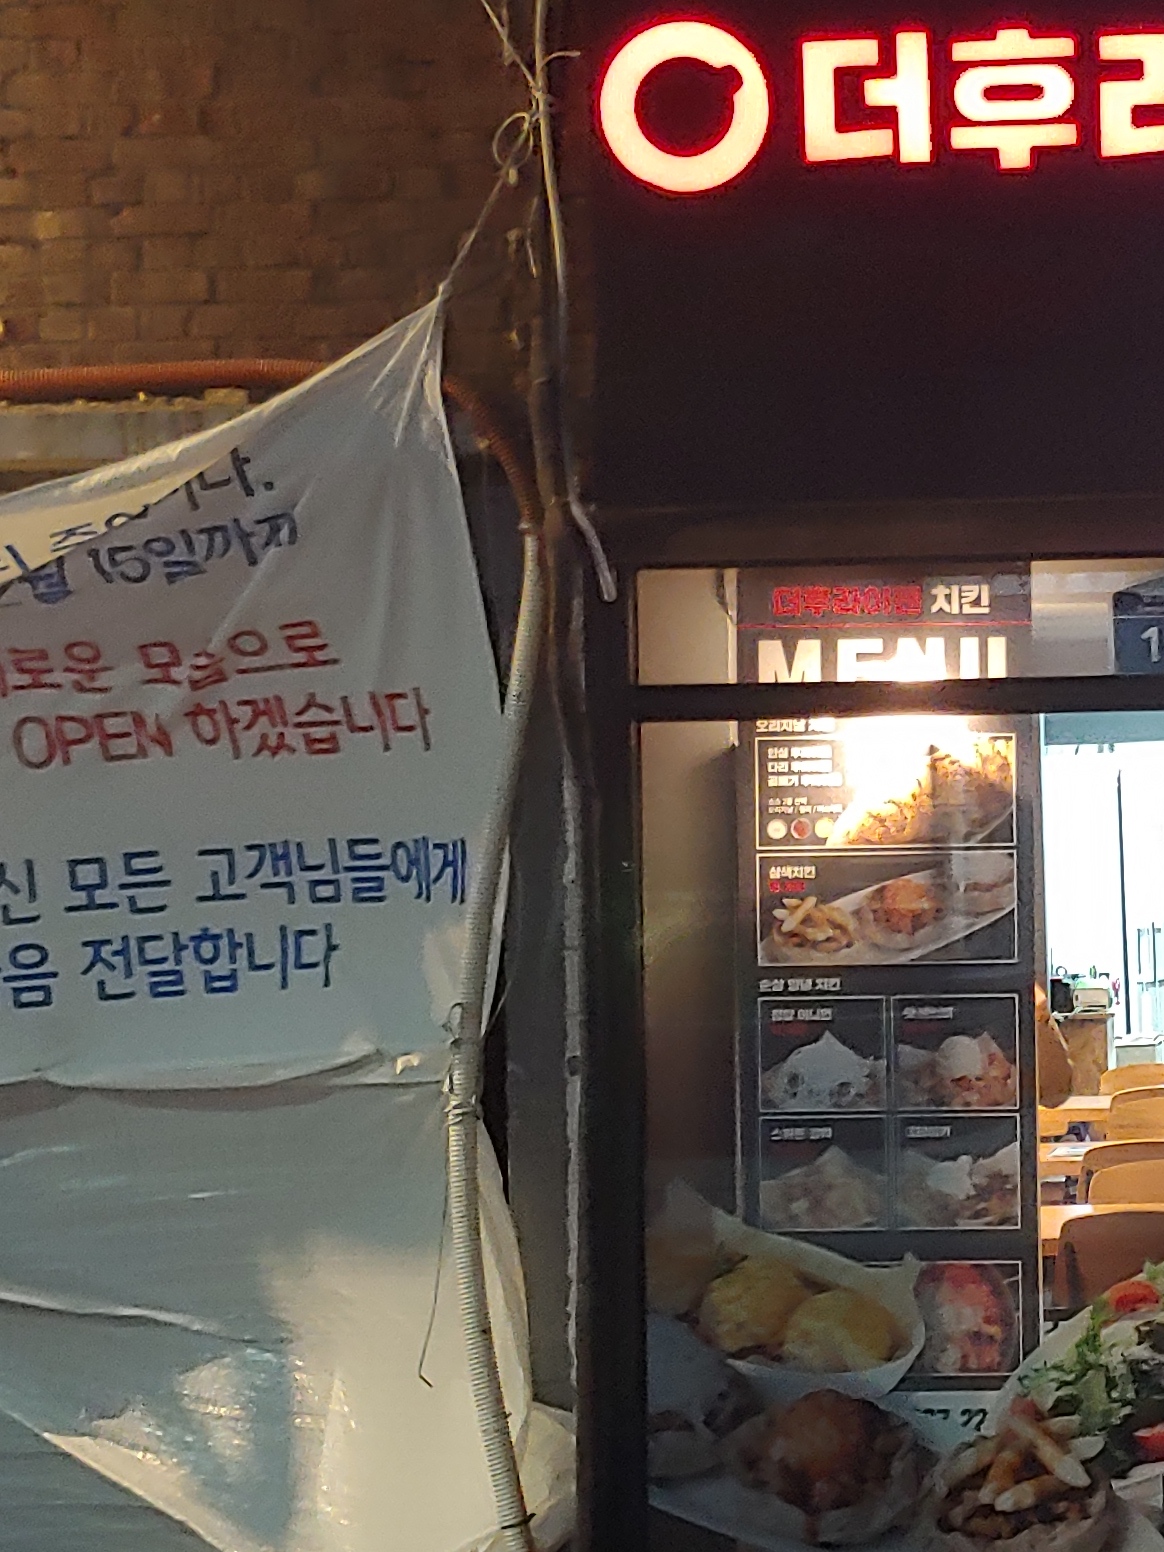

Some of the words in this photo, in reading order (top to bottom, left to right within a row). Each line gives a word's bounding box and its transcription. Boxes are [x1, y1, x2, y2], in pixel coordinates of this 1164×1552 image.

[930, 583, 991, 615] 치킨
[13, 710, 174, 770] OPEN
[183, 687, 433, 760] 하겠습니다
[64, 850, 172, 914] 모든
[194, 836, 467, 905] 고객님들에게
[80, 923, 340, 1001] 전달합니다
